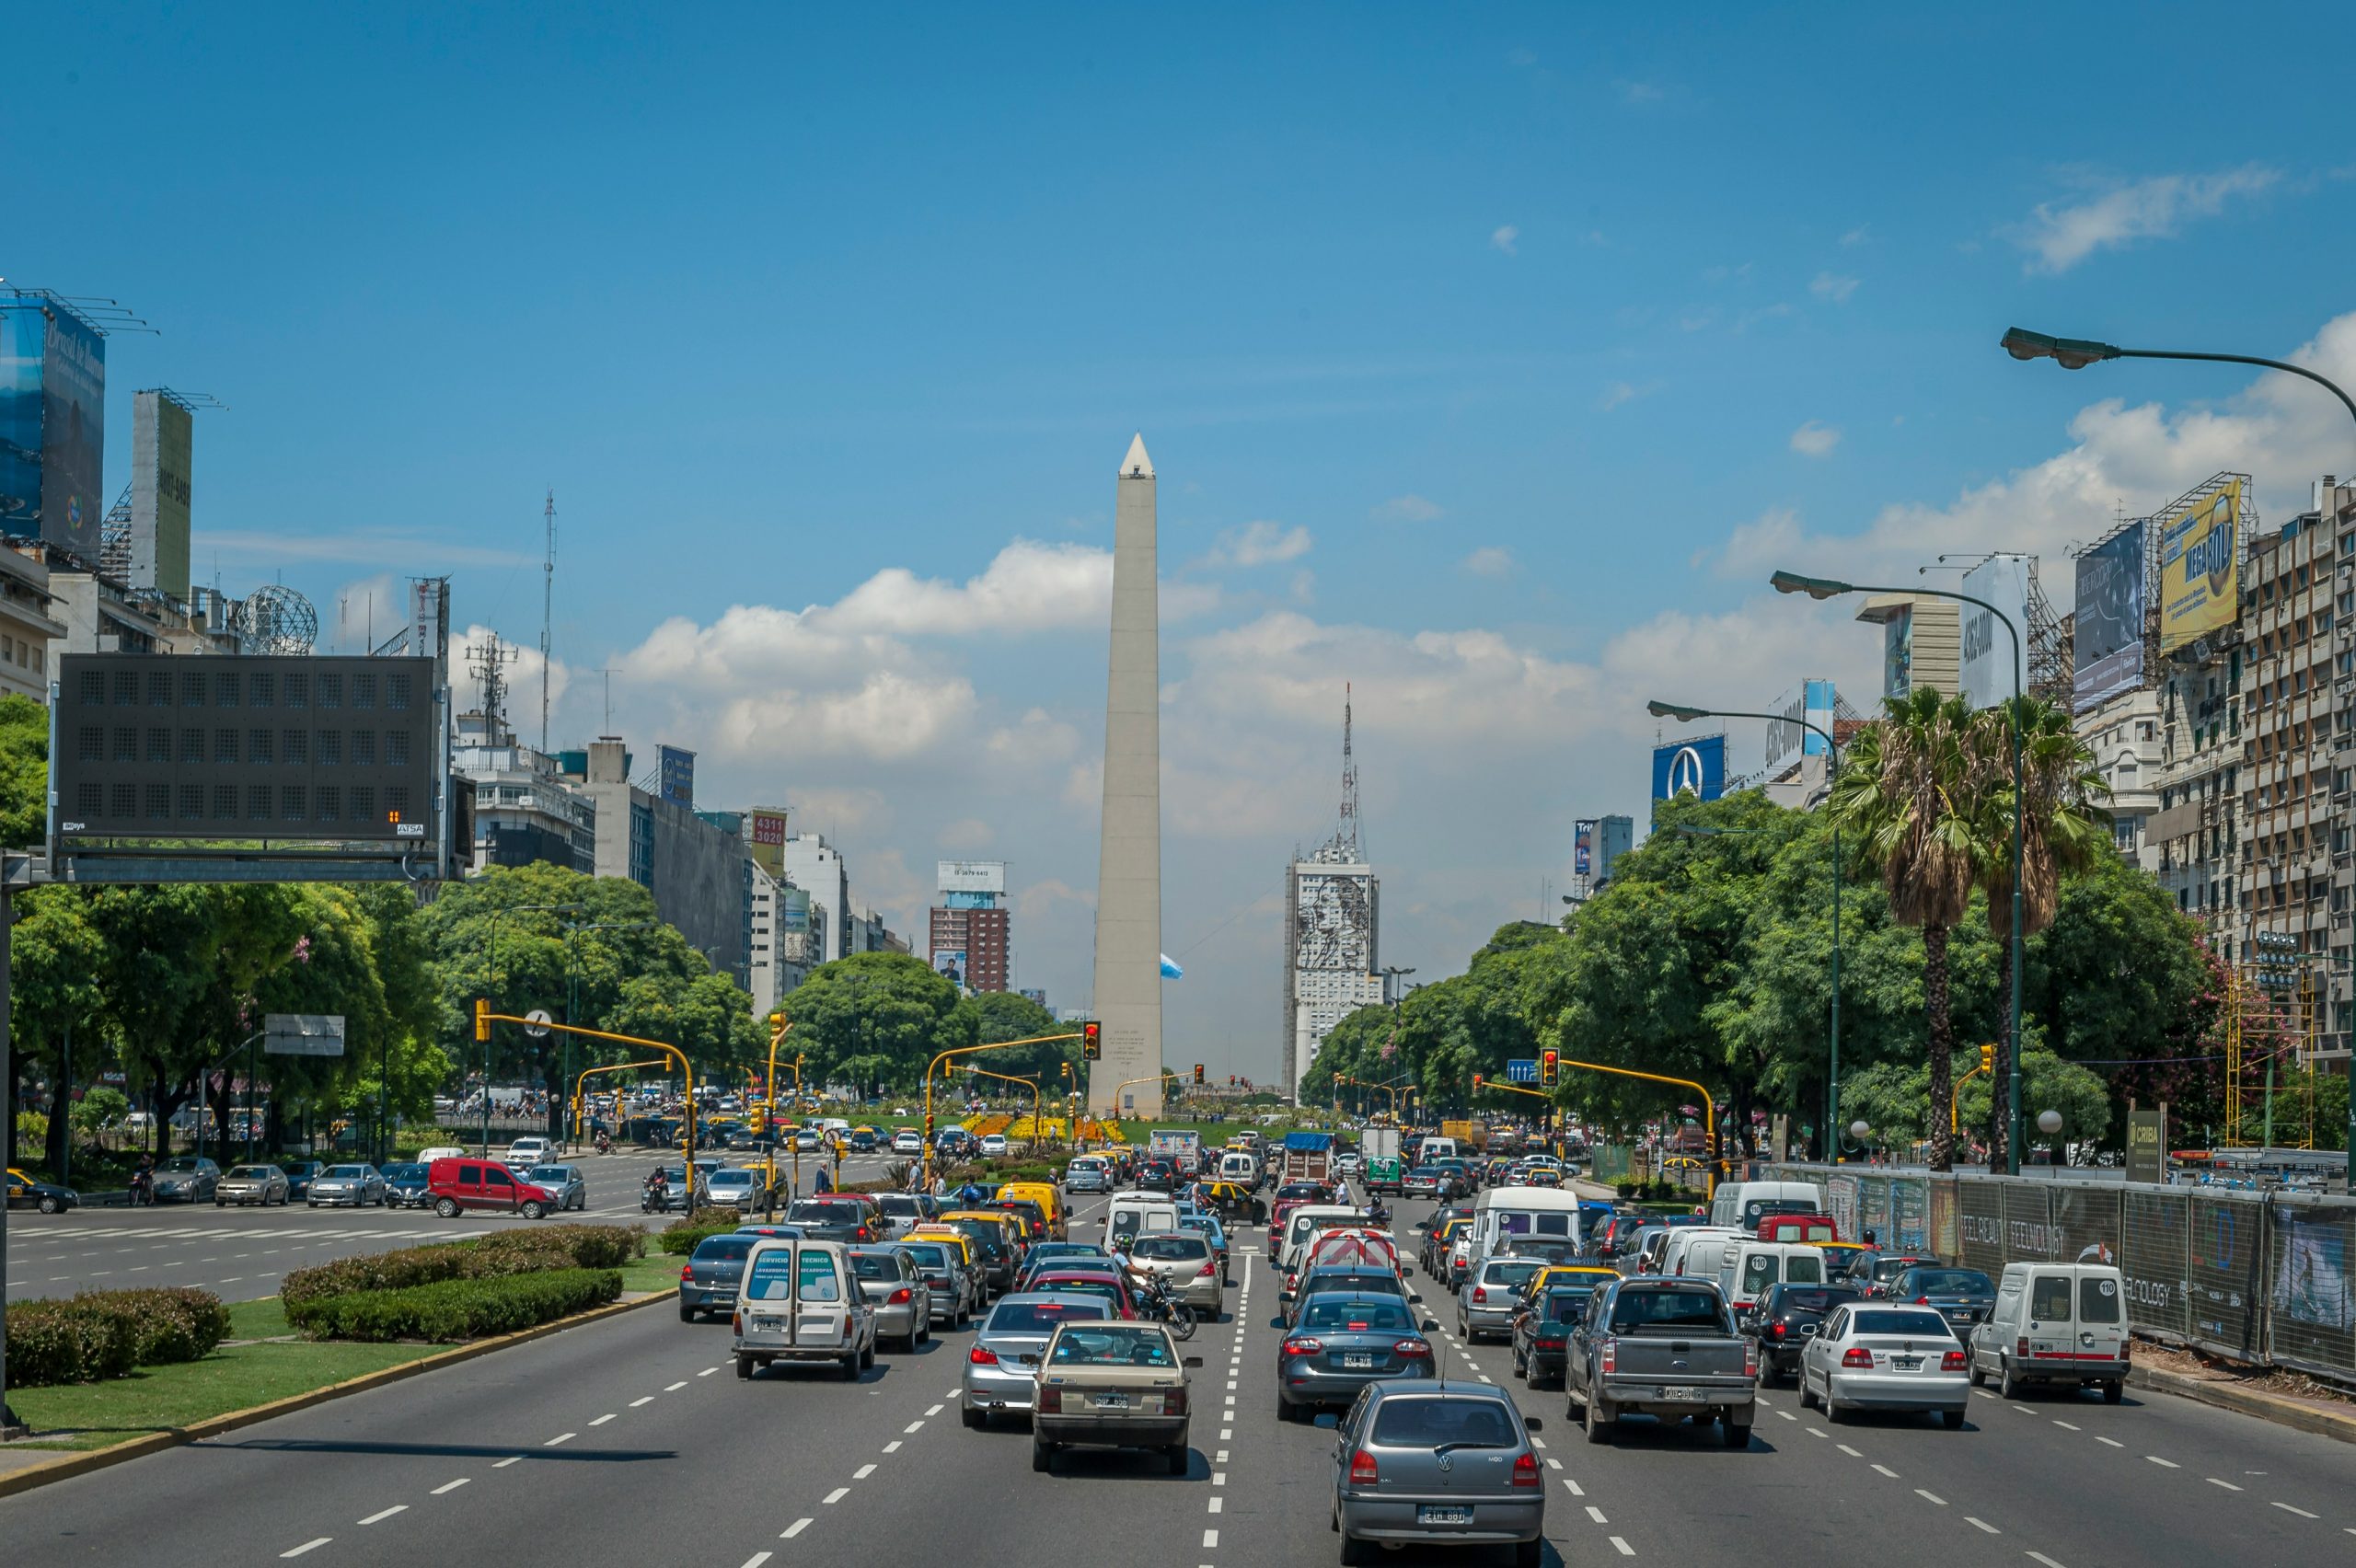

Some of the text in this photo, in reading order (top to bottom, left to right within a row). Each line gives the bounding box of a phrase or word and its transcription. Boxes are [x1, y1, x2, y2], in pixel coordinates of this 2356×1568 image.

[398, 824, 422, 833] ATSA
[757, 818, 782, 830] 4311
[757, 831, 782, 844] 3020
[2136, 1126, 2158, 1143] CRIBA
[1750, 1205, 1761, 1214] 110
[1752, 1259, 1765, 1268] 110
[2101, 1284, 2115, 1293] 110
